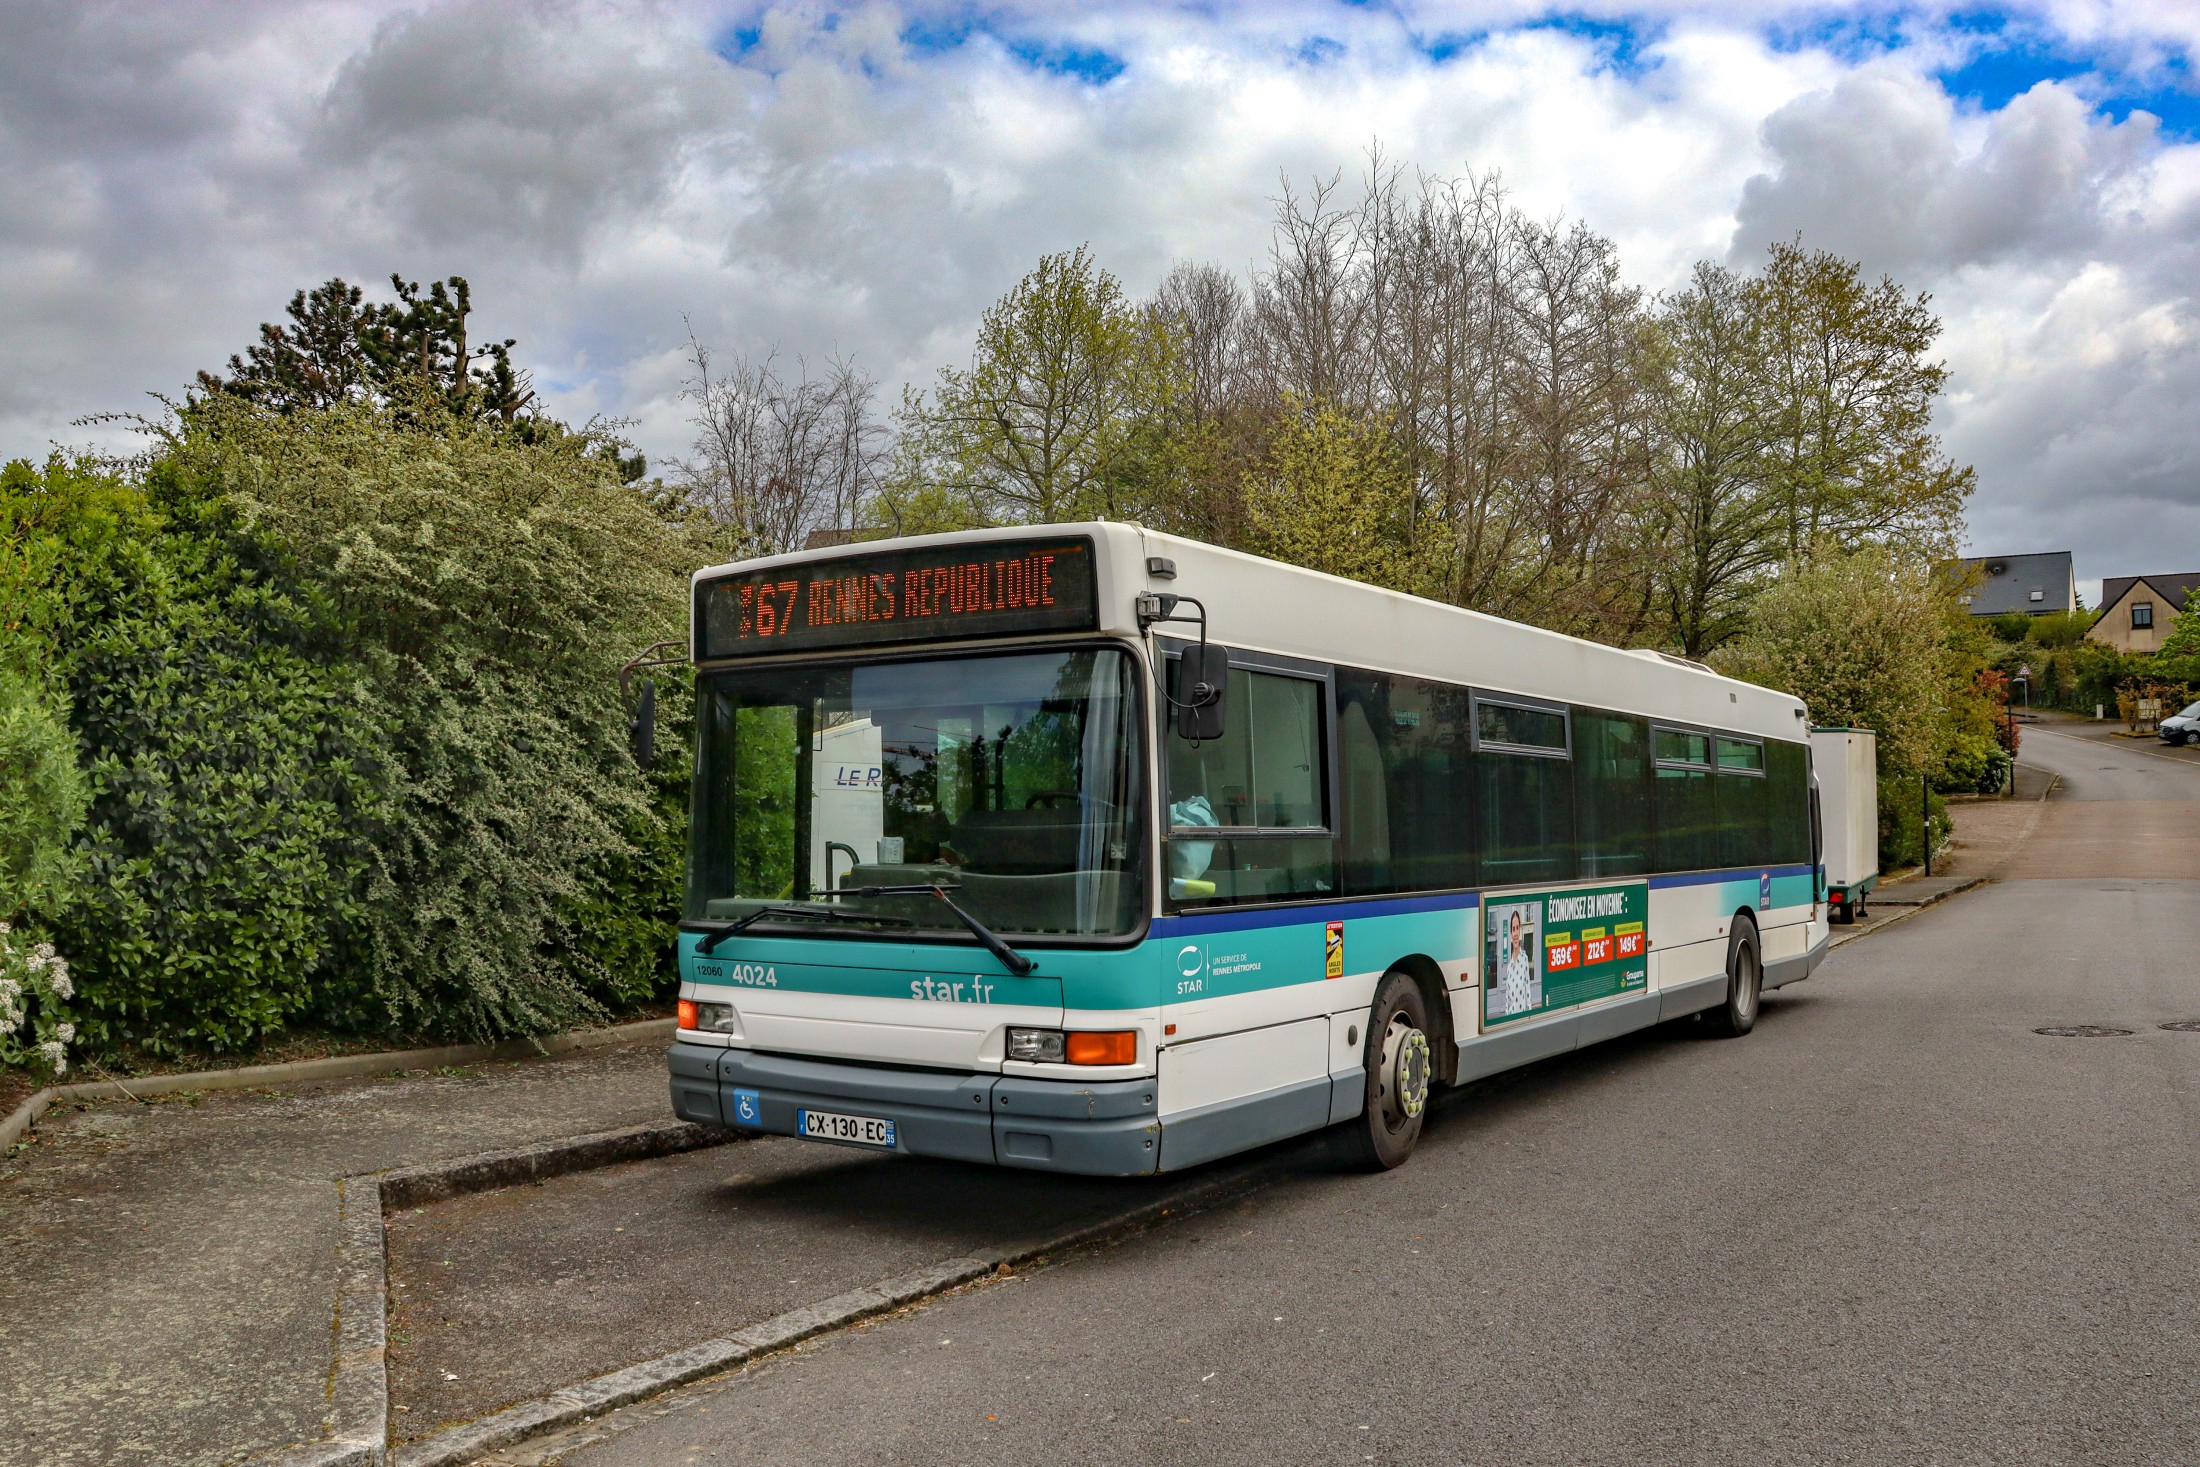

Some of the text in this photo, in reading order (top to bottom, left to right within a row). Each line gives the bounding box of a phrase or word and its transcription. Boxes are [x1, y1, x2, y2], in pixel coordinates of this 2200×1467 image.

[757, 580, 798, 637] 67
[808, 573, 895, 626] RENNES
[905, 555, 1054, 617] REPUBLIQUE
[836, 766, 861, 787] LE
[1548, 895, 1586, 923] ÉCONOMISEZ
[1587, 896, 1596, 918] EN
[1213, 957, 1220, 965] UN
[1220, 954, 1240, 964] SERVICE
[697, 965, 723, 977] 12060
[732, 964, 778, 987] 4024
[1212, 962, 1262, 976] RENNES MÉTROPOLE
[910, 974, 994, 1004] star.fr
[1177, 979, 1203, 995] STAR
[886, 1134, 895, 1144] 35
